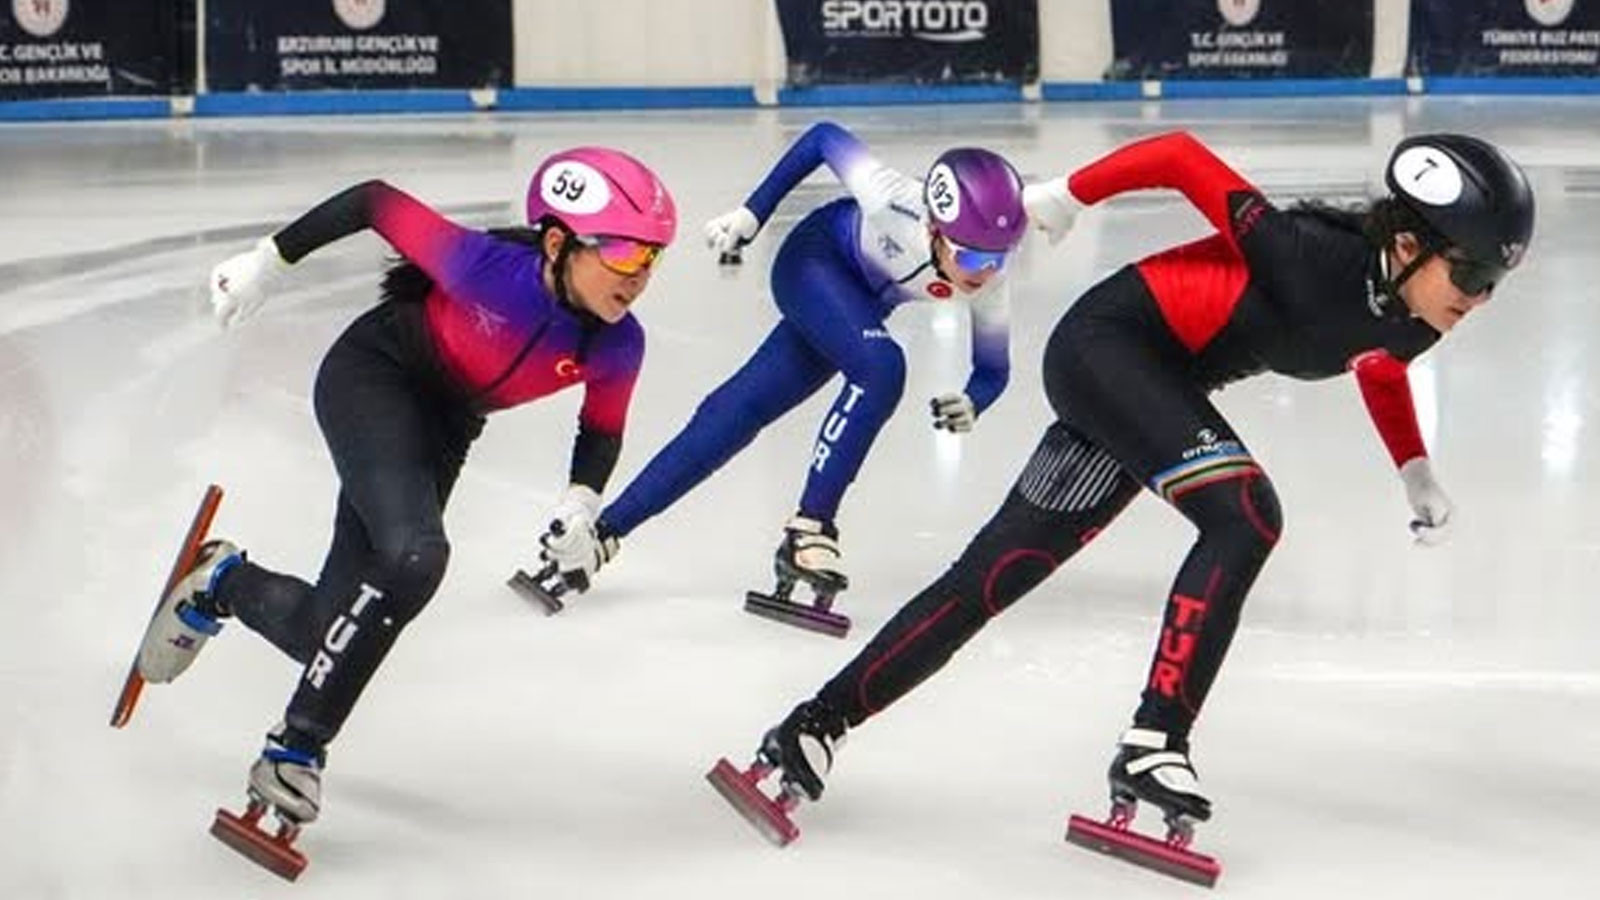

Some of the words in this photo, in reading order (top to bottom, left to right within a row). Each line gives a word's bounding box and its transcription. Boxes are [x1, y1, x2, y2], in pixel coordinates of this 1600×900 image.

[822, 1, 988, 29] SPORTOTO
[551, 169, 587, 202] 59
[931, 172, 954, 214] 192
[814, 383, 865, 473] TUR
[306, 582, 383, 690] TUR
[1151, 594, 1207, 697] TUR
